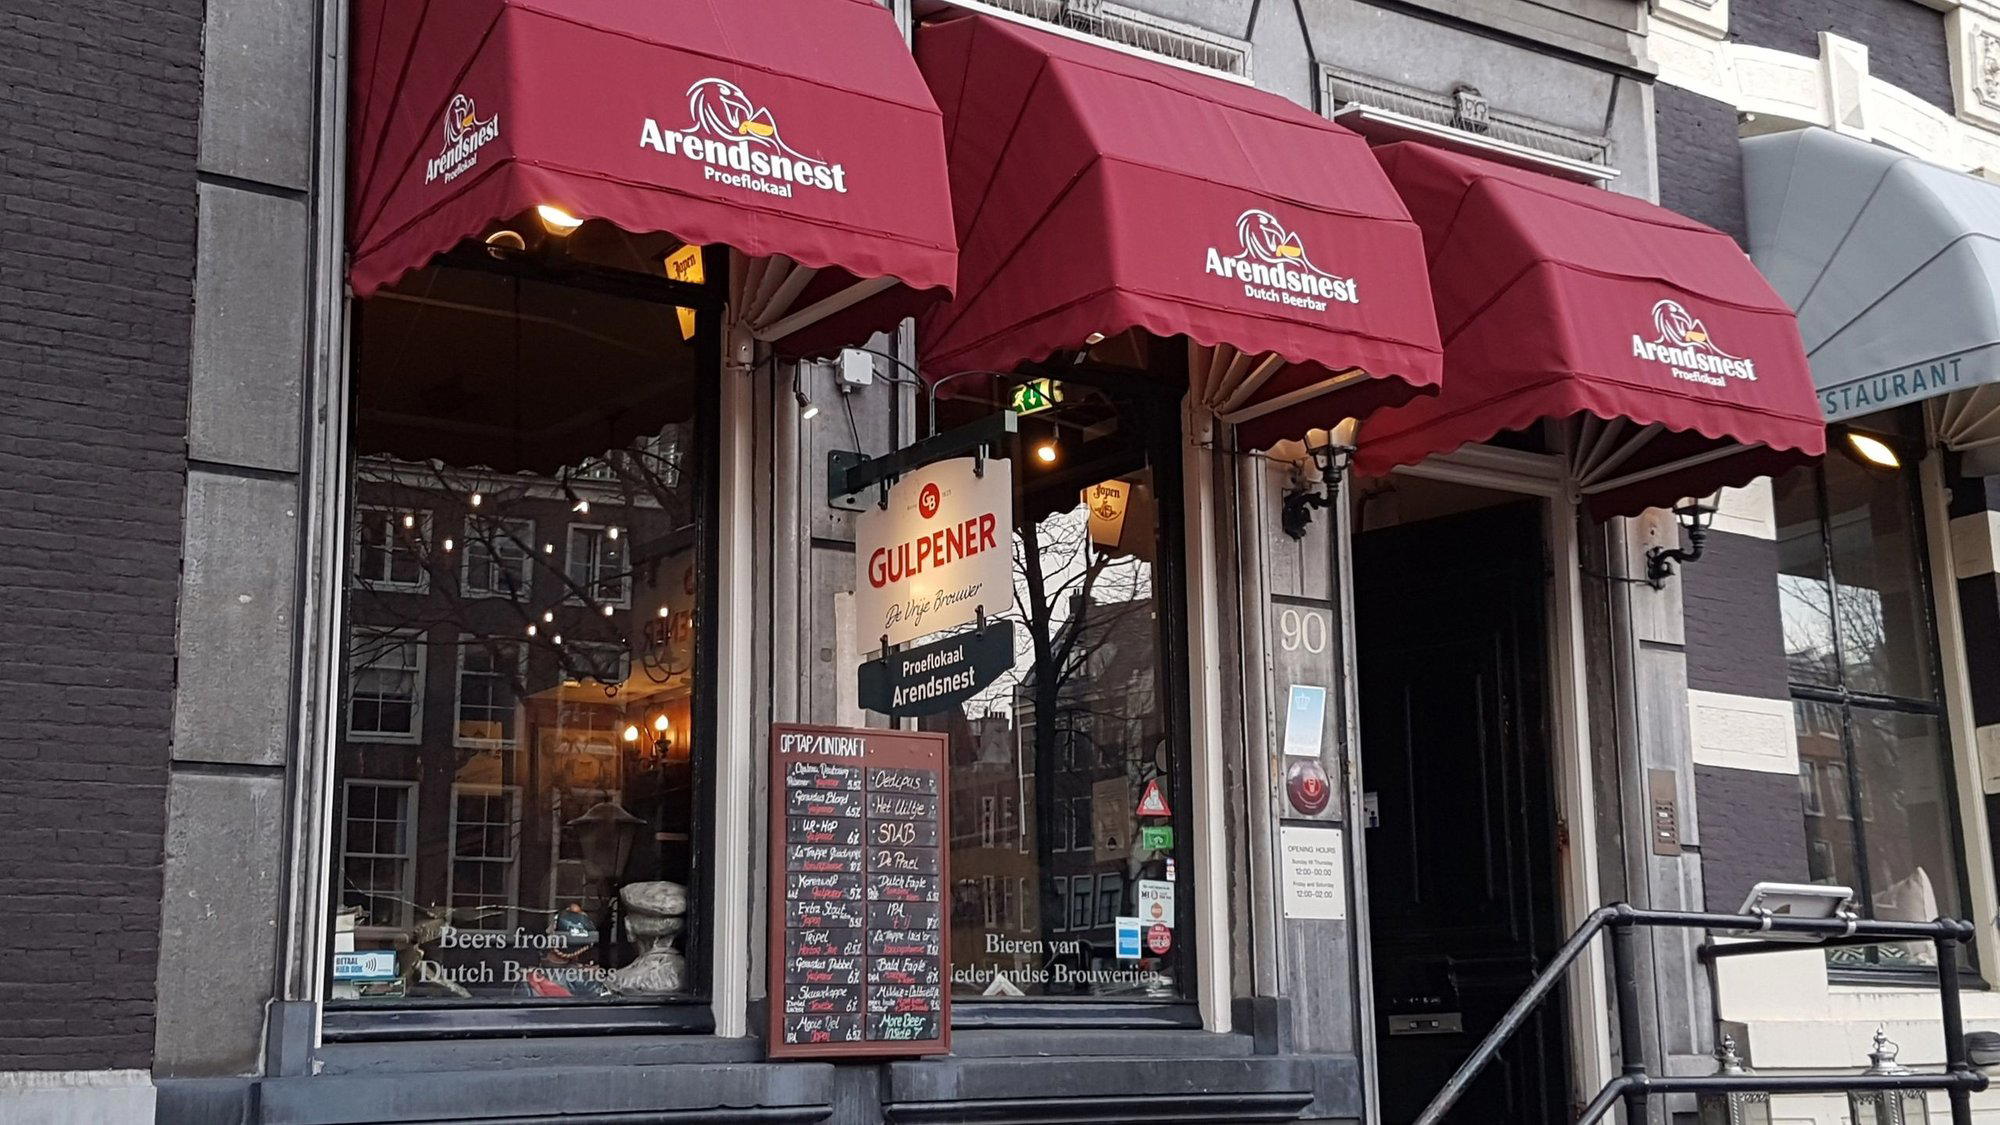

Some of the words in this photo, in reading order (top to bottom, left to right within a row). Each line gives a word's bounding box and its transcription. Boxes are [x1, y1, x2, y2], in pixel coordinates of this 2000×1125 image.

[425, 112, 499, 185] Arendsnest
[640, 118, 848, 193] Arendsnest
[444, 152, 477, 184] Proeflokaal
[704, 165, 792, 198] Proeflokaal
[1205, 247, 1359, 304] Arendsnest
[1244, 284, 1280, 303] Dutch
[1282, 292, 1327, 312] Beerbar
[1632, 334, 1758, 381] Arendsnest
[1671, 367, 1726, 387] Proeflokaal
[1817, 358, 1961, 415] STAURANT
[885, 603, 901, 629] De
[904, 598, 930, 627] Vrije
[933, 582, 983, 613] Brouwer
[1280, 609, 1327, 654] 90
[902, 645, 964, 678] Proeflokaal
[892, 666, 975, 708] Arendsnest
[875, 770, 921, 791] Oedipus
[825, 791, 849, 805] Blond
[875, 796, 892, 813] Het
[895, 798, 925, 820] Uiltje
[877, 851, 892, 868] De
[1288, 845, 1314, 853] OPENING
[878, 875, 904, 888] Dutch
[905, 875, 927, 891] Eagle
[798, 902, 821, 915] Extra
[822, 901, 846, 916] Stout
[887, 903, 905, 917] IPA
[439, 926, 506, 949] Beers
[513, 927, 568, 948] from
[986, 934, 1043, 954] Bieren
[1049, 940, 1080, 954] van
[419, 960, 494, 983] Dutch
[502, 961, 617, 983] Breweries
[877, 958, 900, 971] Bald
[902, 958, 926, 975] Eagle
[1054, 963, 1160, 987] Brouwerijen
[879, 1013, 903, 1027] More
[903, 1013, 926, 1027] Beer
